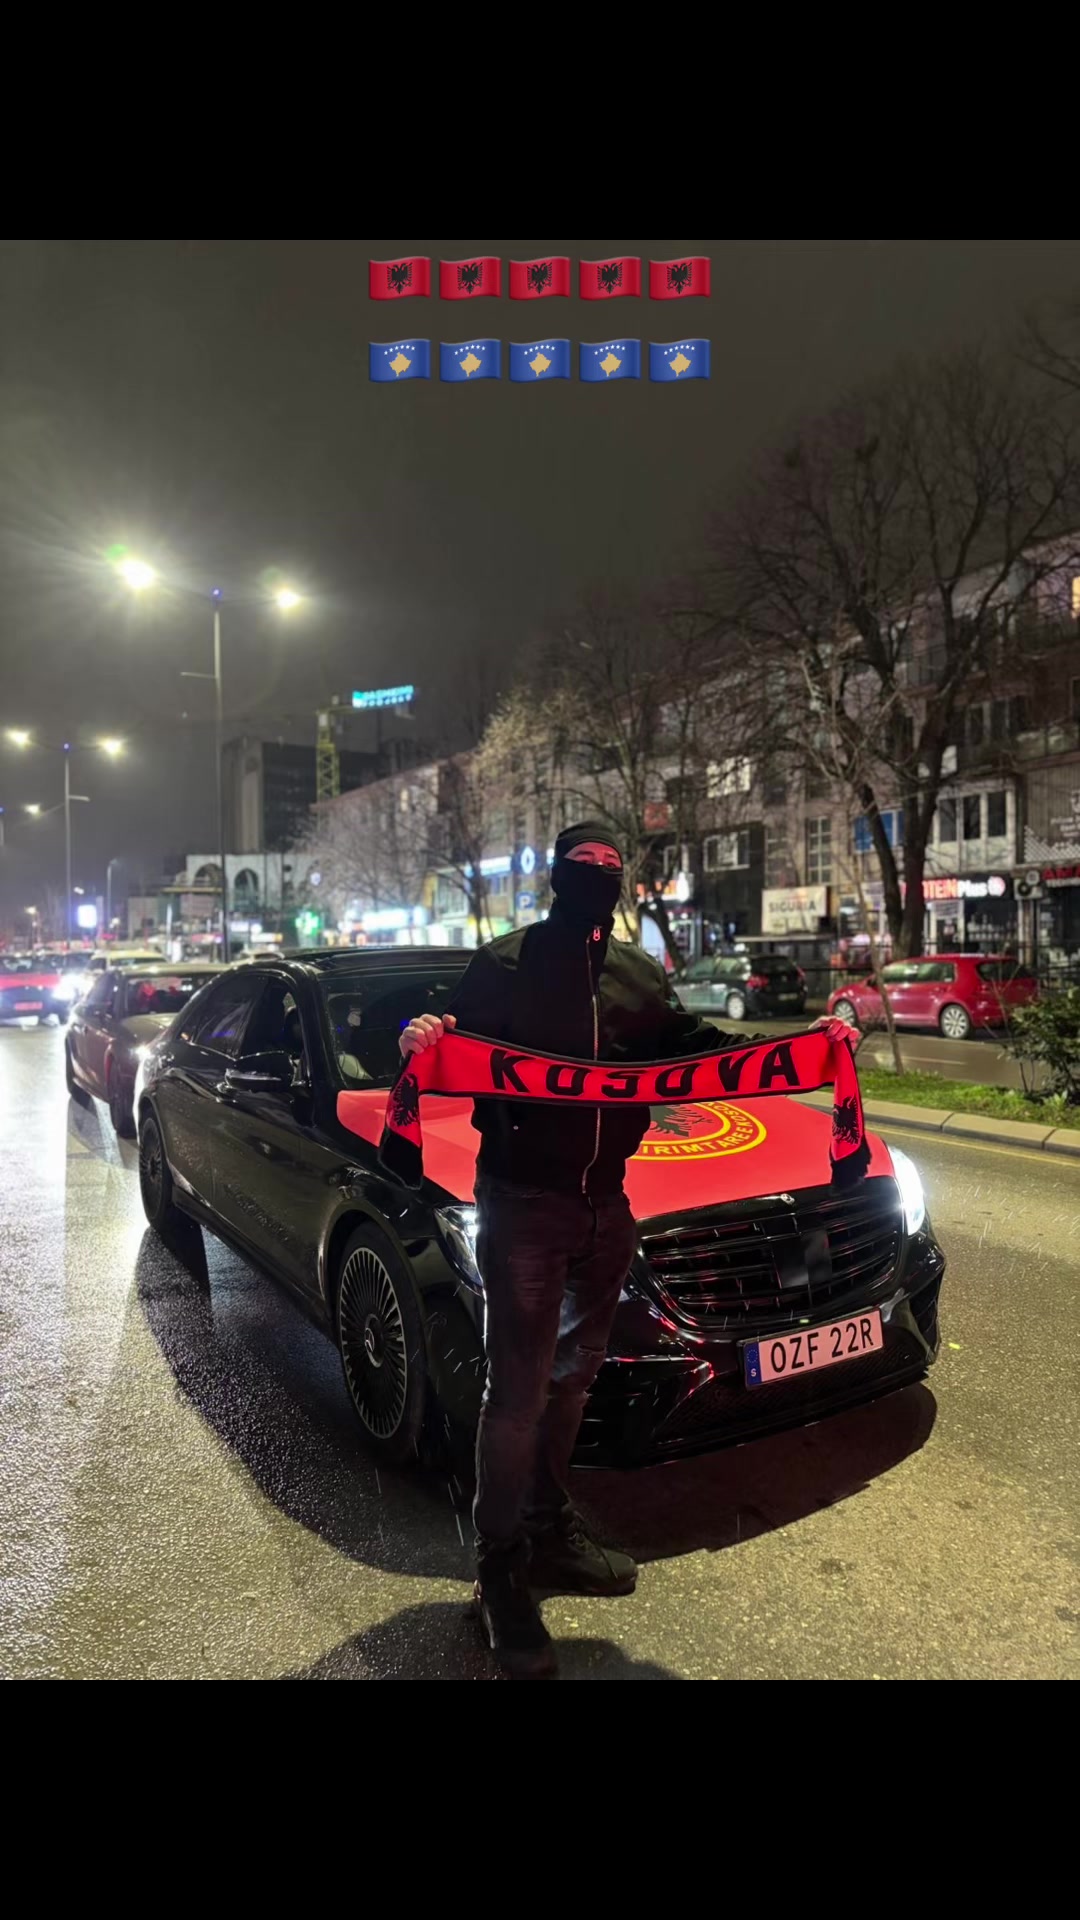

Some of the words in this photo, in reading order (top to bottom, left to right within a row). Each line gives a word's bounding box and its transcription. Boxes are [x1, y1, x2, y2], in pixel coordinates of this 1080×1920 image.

[489, 1041, 801, 1099] KOSOVA
[750, 1368, 757, 1377] S
[770, 1331, 819, 1373] OZF
[830, 1318, 874, 1359] 22R
